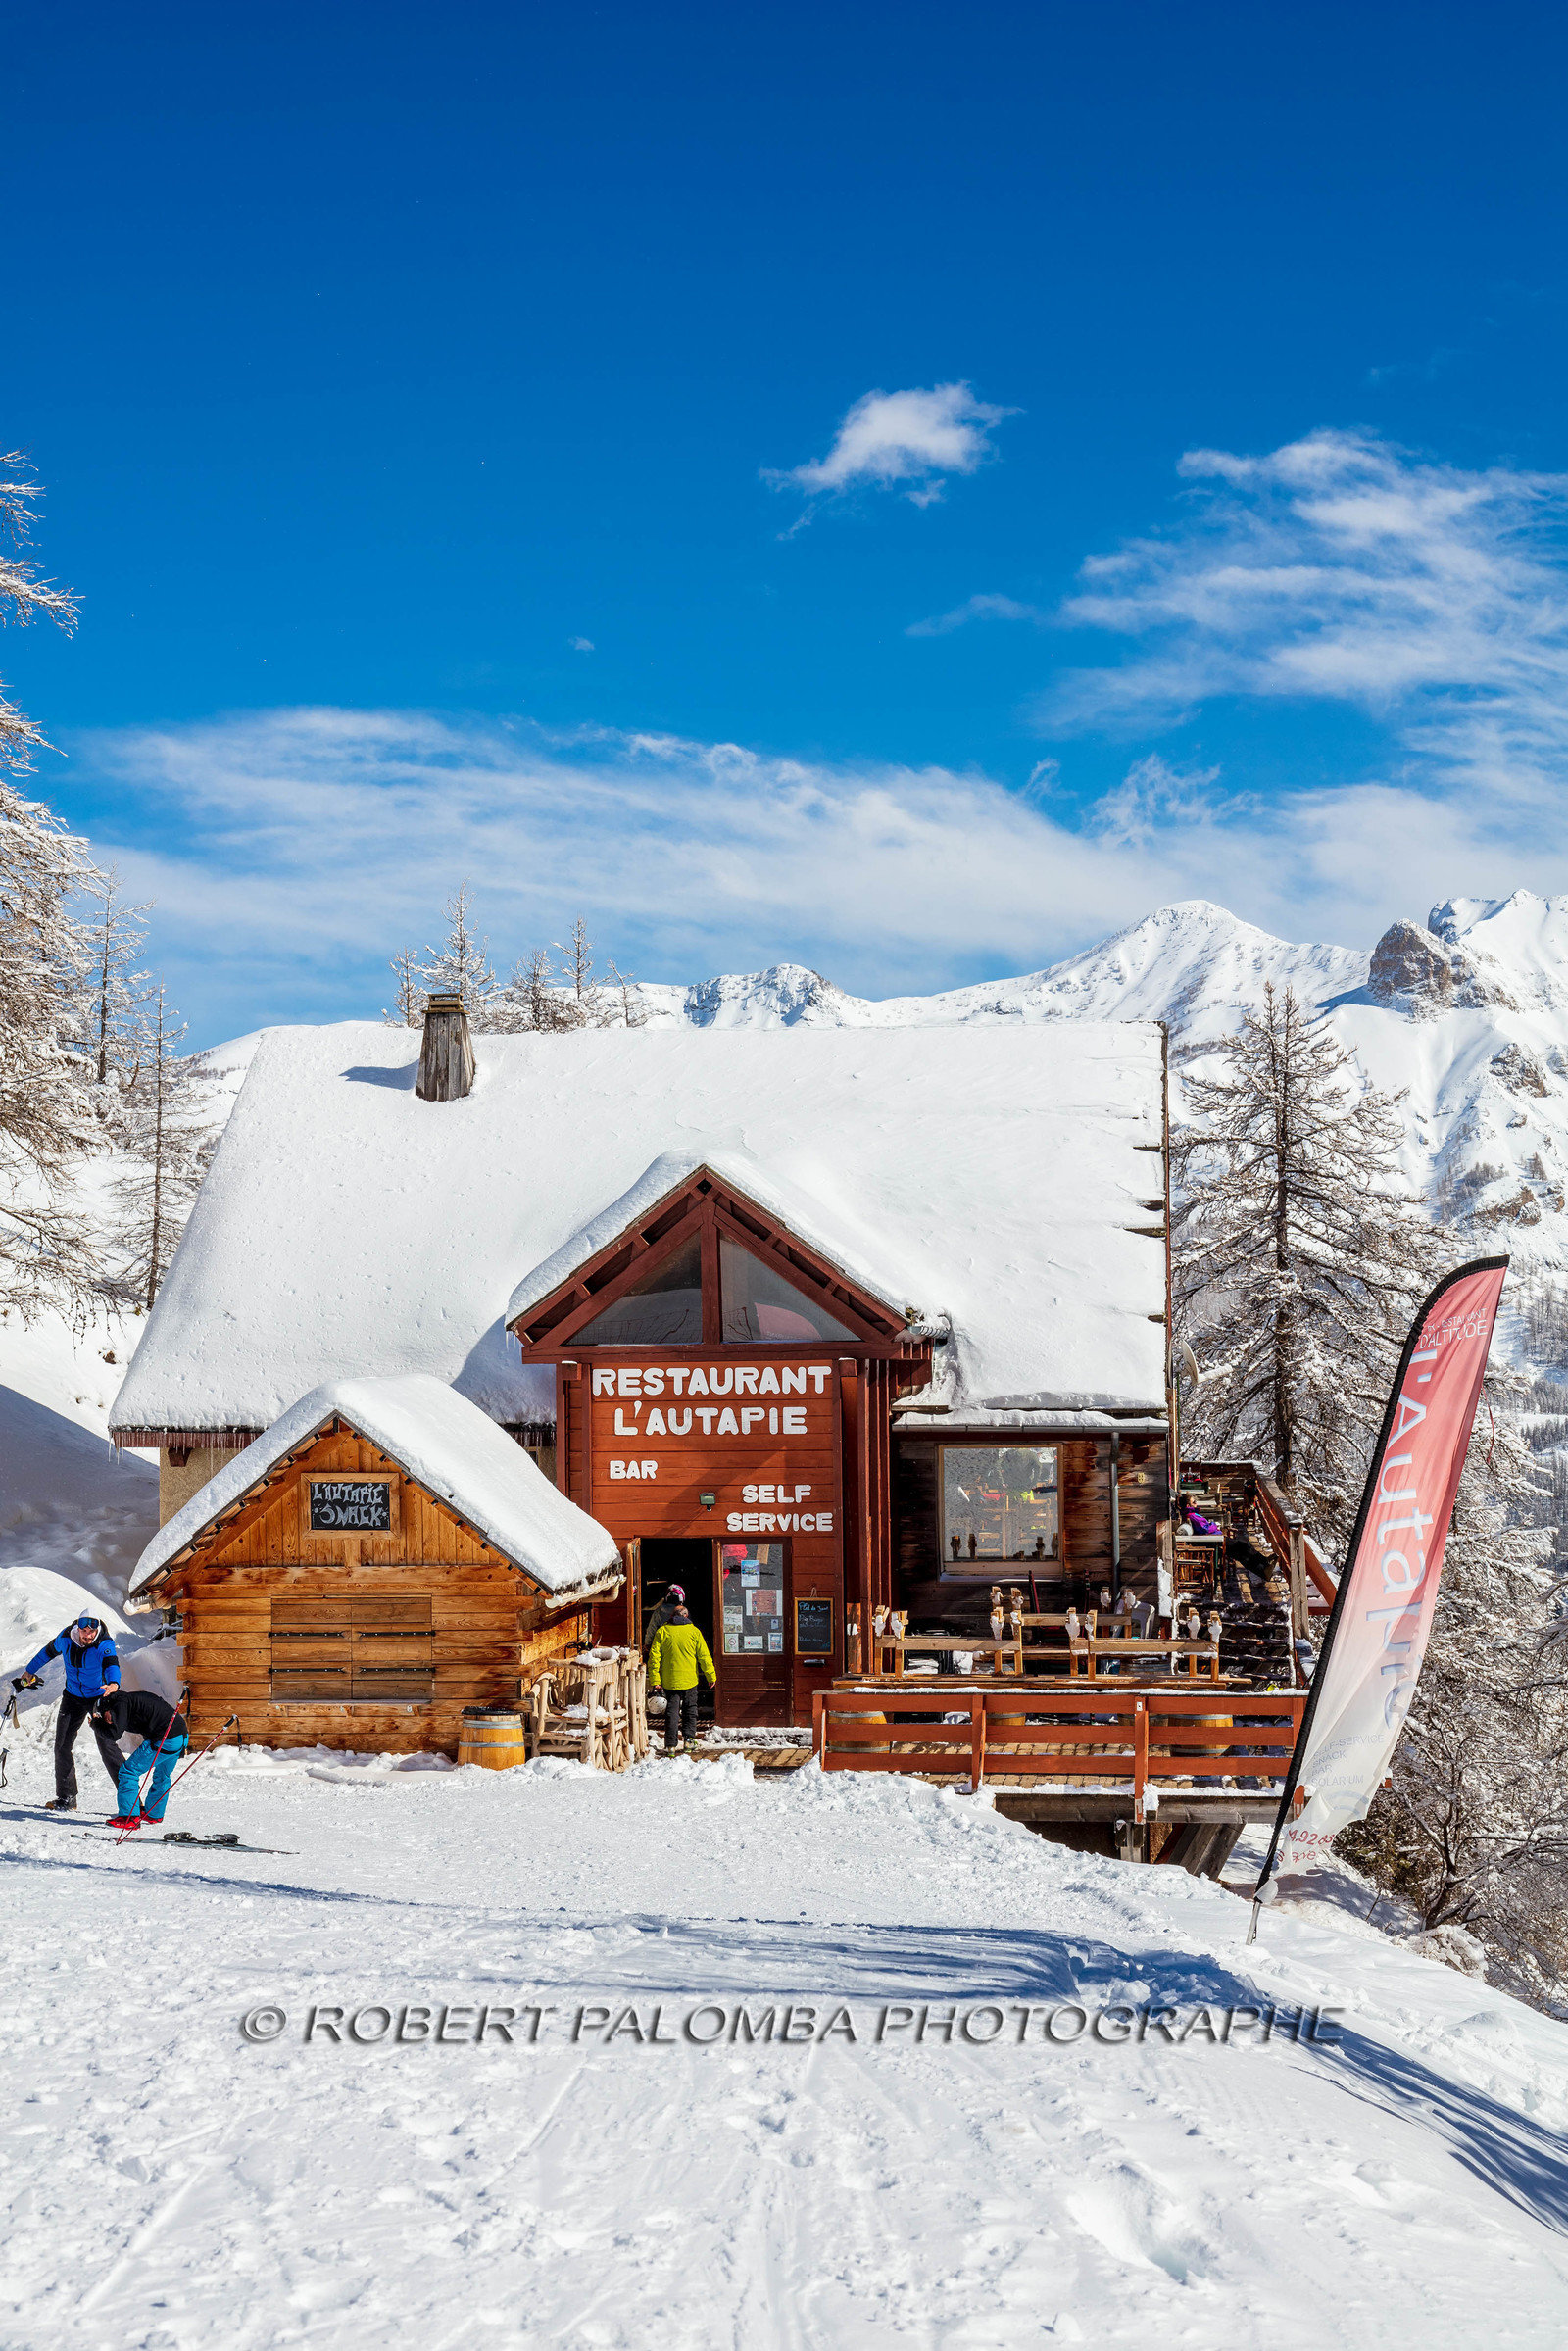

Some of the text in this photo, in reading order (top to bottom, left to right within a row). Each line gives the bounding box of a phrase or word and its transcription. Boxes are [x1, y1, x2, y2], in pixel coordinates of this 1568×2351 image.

[592, 1366, 832, 1396] RESTAURANT
[613, 1400, 808, 1436] L'AUTAPIE
[610, 1460, 658, 1480] BAR
[742, 1484, 811, 1504] SELF
[319, 1503, 383, 1528] SNACK
[726, 1512, 833, 1532] SERVICE
